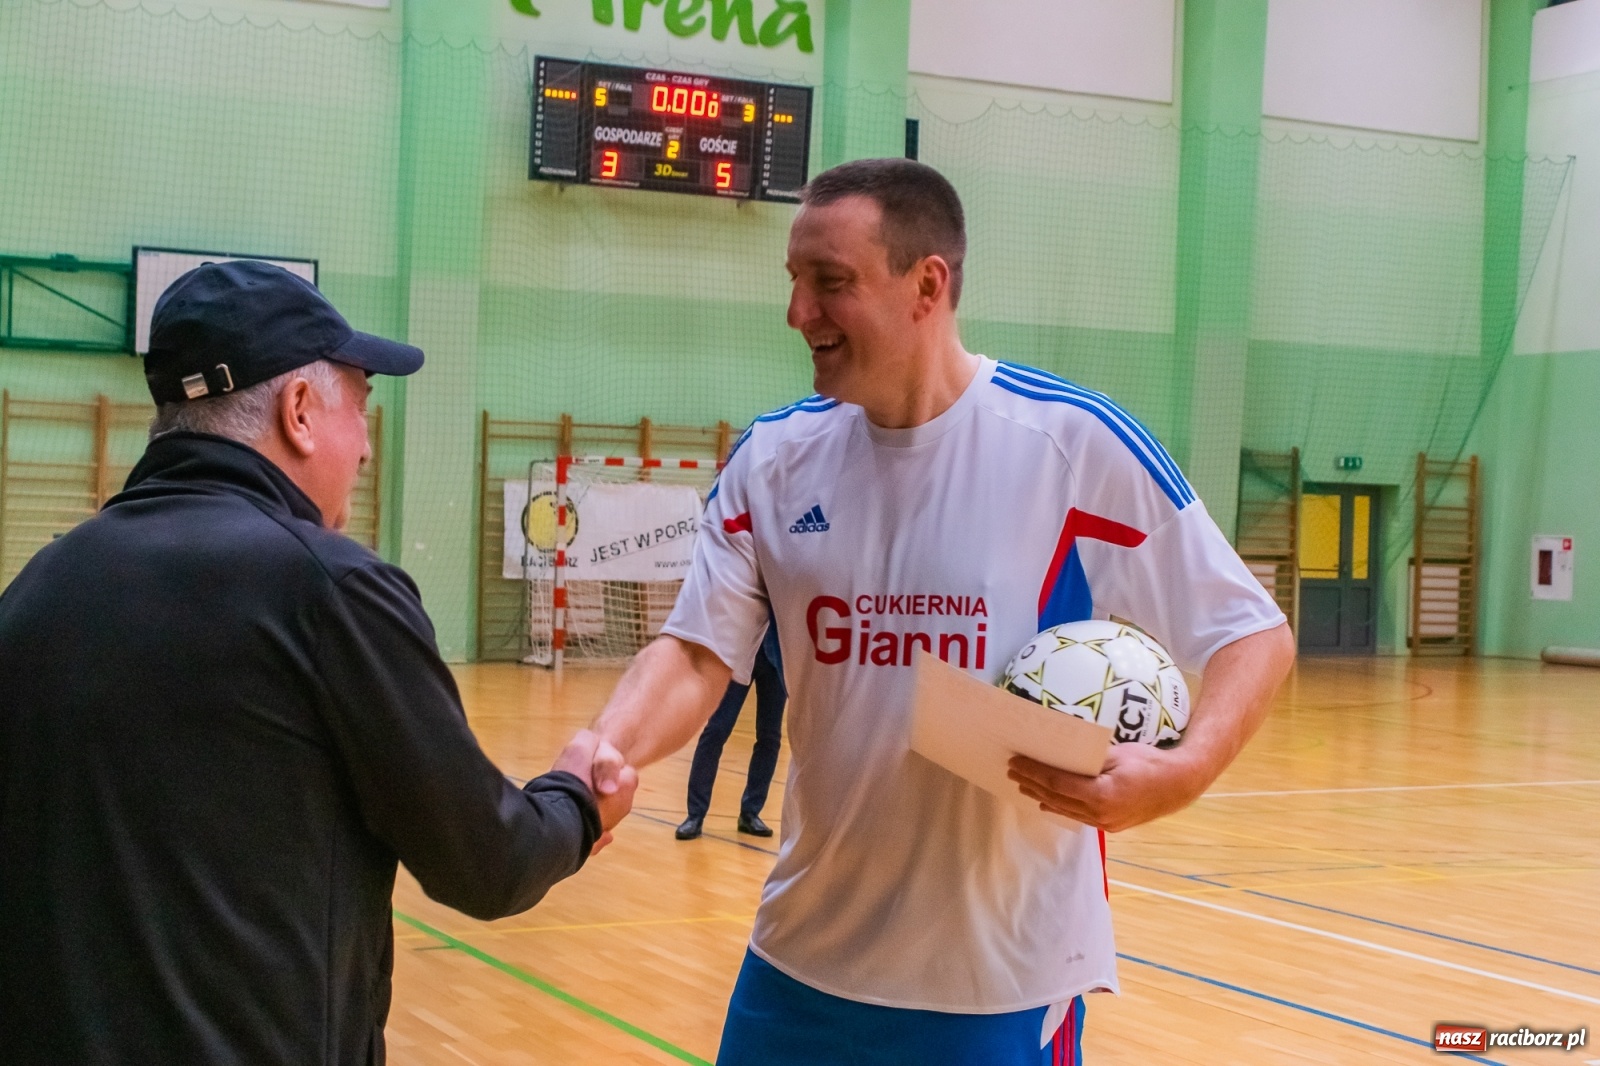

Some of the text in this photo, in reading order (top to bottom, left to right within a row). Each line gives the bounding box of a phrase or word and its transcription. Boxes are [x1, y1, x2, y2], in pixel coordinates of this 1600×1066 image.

[645, 72, 666, 82] CZAS
[671, 74, 692, 85] CZAS
[594, 87, 607, 107] 5
[743, 103, 755, 123] 3
[594, 126, 663, 147] GOSPODARZE
[700, 134, 738, 154] GOŚCIE
[667, 140, 680, 159] 2
[601, 151, 618, 177] 3
[716, 162, 731, 188] 5
[789, 522, 830, 534] adidas
[590, 538, 630, 563] JEST
[634, 531, 651, 550] W
[855, 594, 988, 617] CUKIERNIA
[806, 595, 988, 670] Gianni
[1113, 688, 1148, 744] ECT
